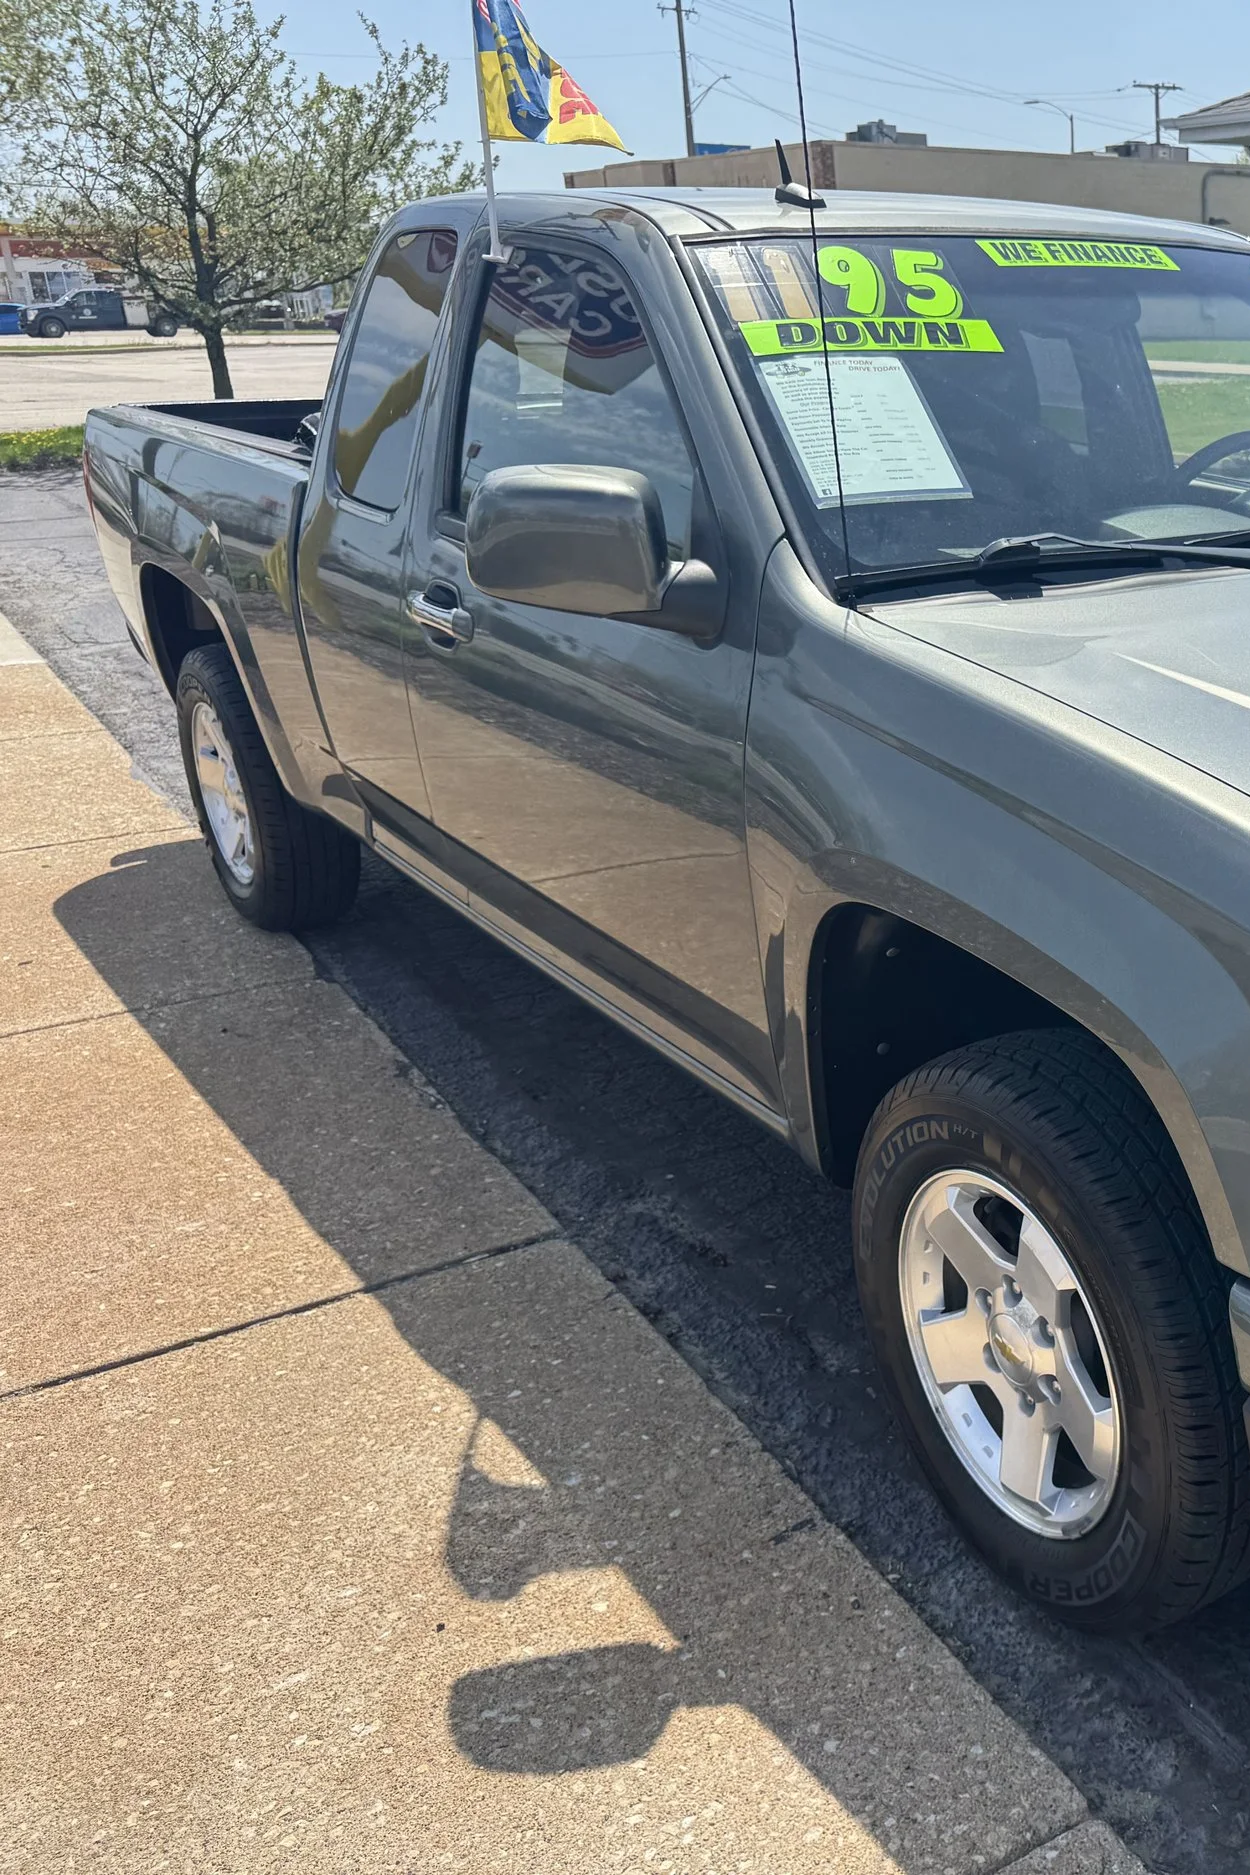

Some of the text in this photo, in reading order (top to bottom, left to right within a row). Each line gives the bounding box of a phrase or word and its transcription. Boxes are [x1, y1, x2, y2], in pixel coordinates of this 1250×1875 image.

[989, 242, 1168, 267] WE FINANCE
[776, 321, 970, 349] DOWN
[813, 359, 873, 367] FINANCE TODAY
[848, 365, 871, 373] DRIVE
[858, 1118, 950, 1263] EVOLUTION
[1028, 1512, 1146, 1605] COOPER
